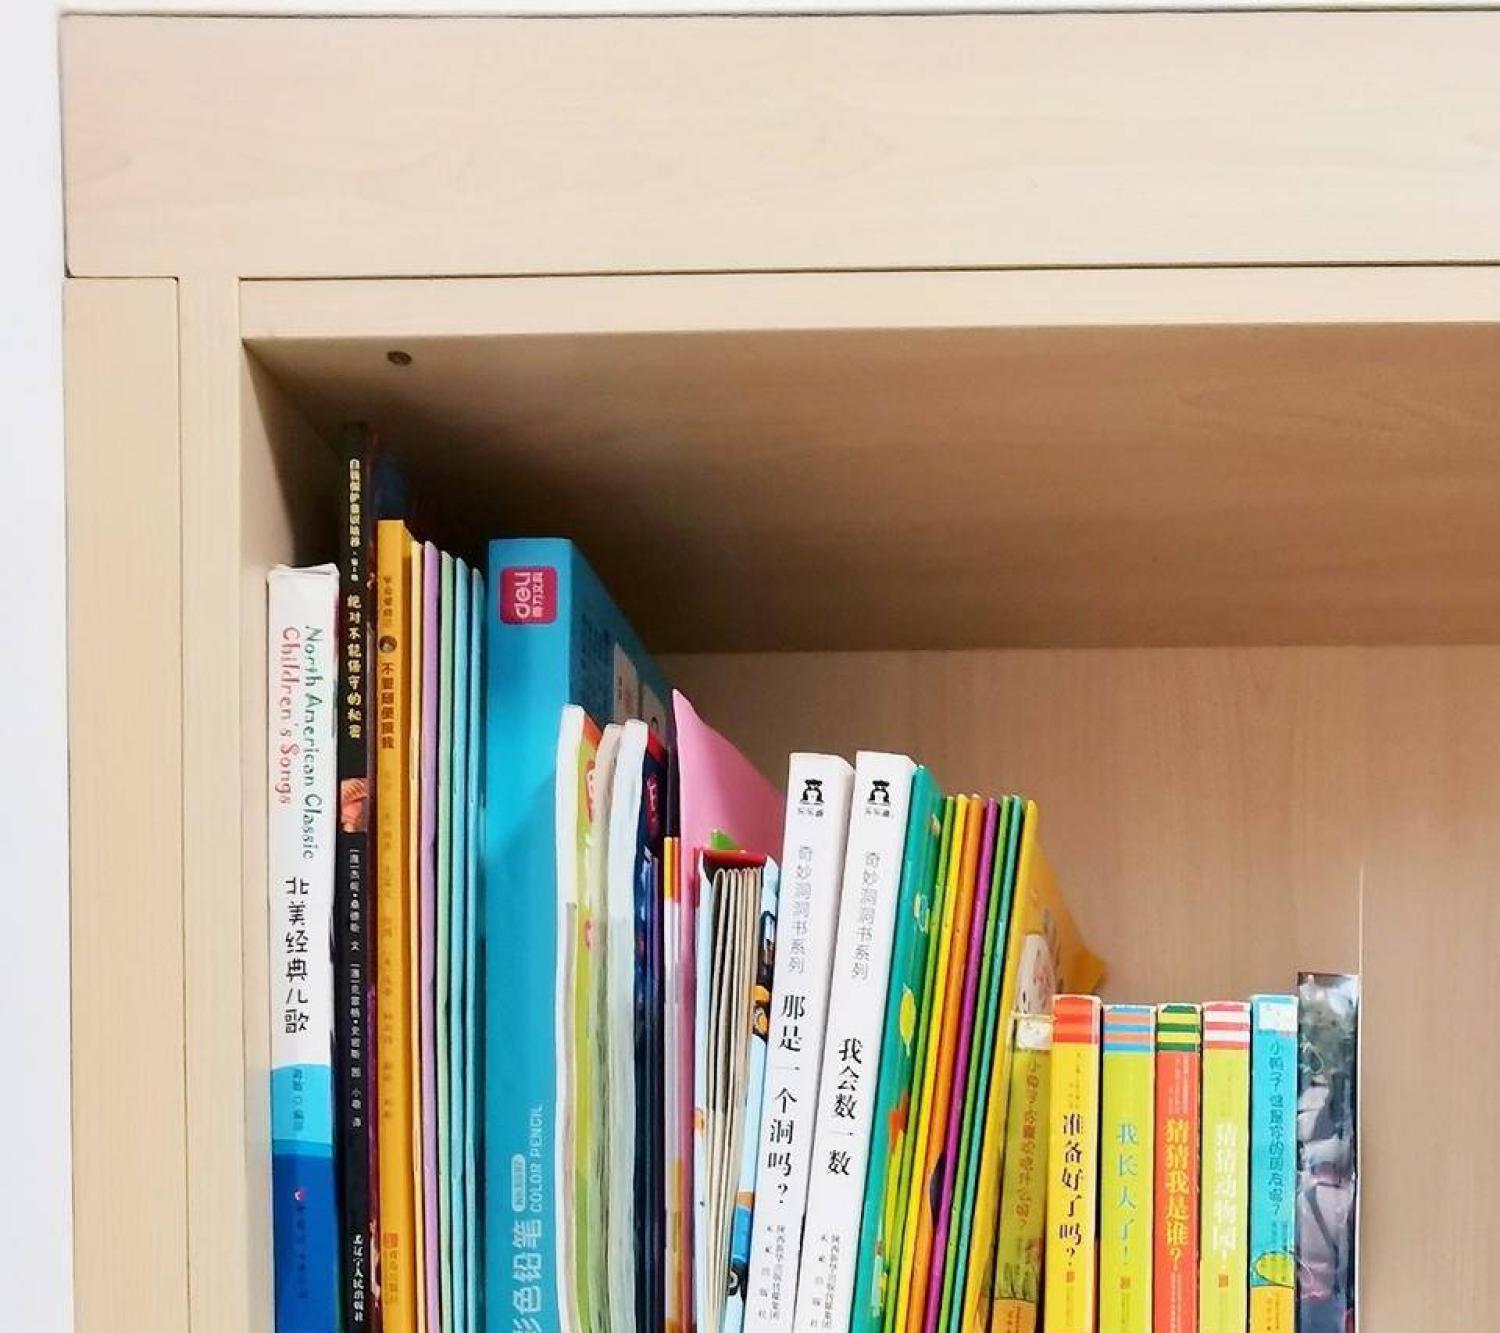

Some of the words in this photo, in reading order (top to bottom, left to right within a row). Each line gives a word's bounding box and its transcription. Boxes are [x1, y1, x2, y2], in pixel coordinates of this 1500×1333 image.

[514, 571, 532, 619] deli
[278, 625, 301, 738] Children's
[304, 625, 325, 686] North
[303, 693, 324, 782] American
[273, 742, 300, 805] Songs
[302, 792, 324, 860] Classic
[284, 876, 310, 1035] 北美经典儿歌
[529, 1105, 544, 1157] PENCIL
[827, 1037, 864, 1176] 我会数一数
[529, 1163, 544, 1213] COLOR
